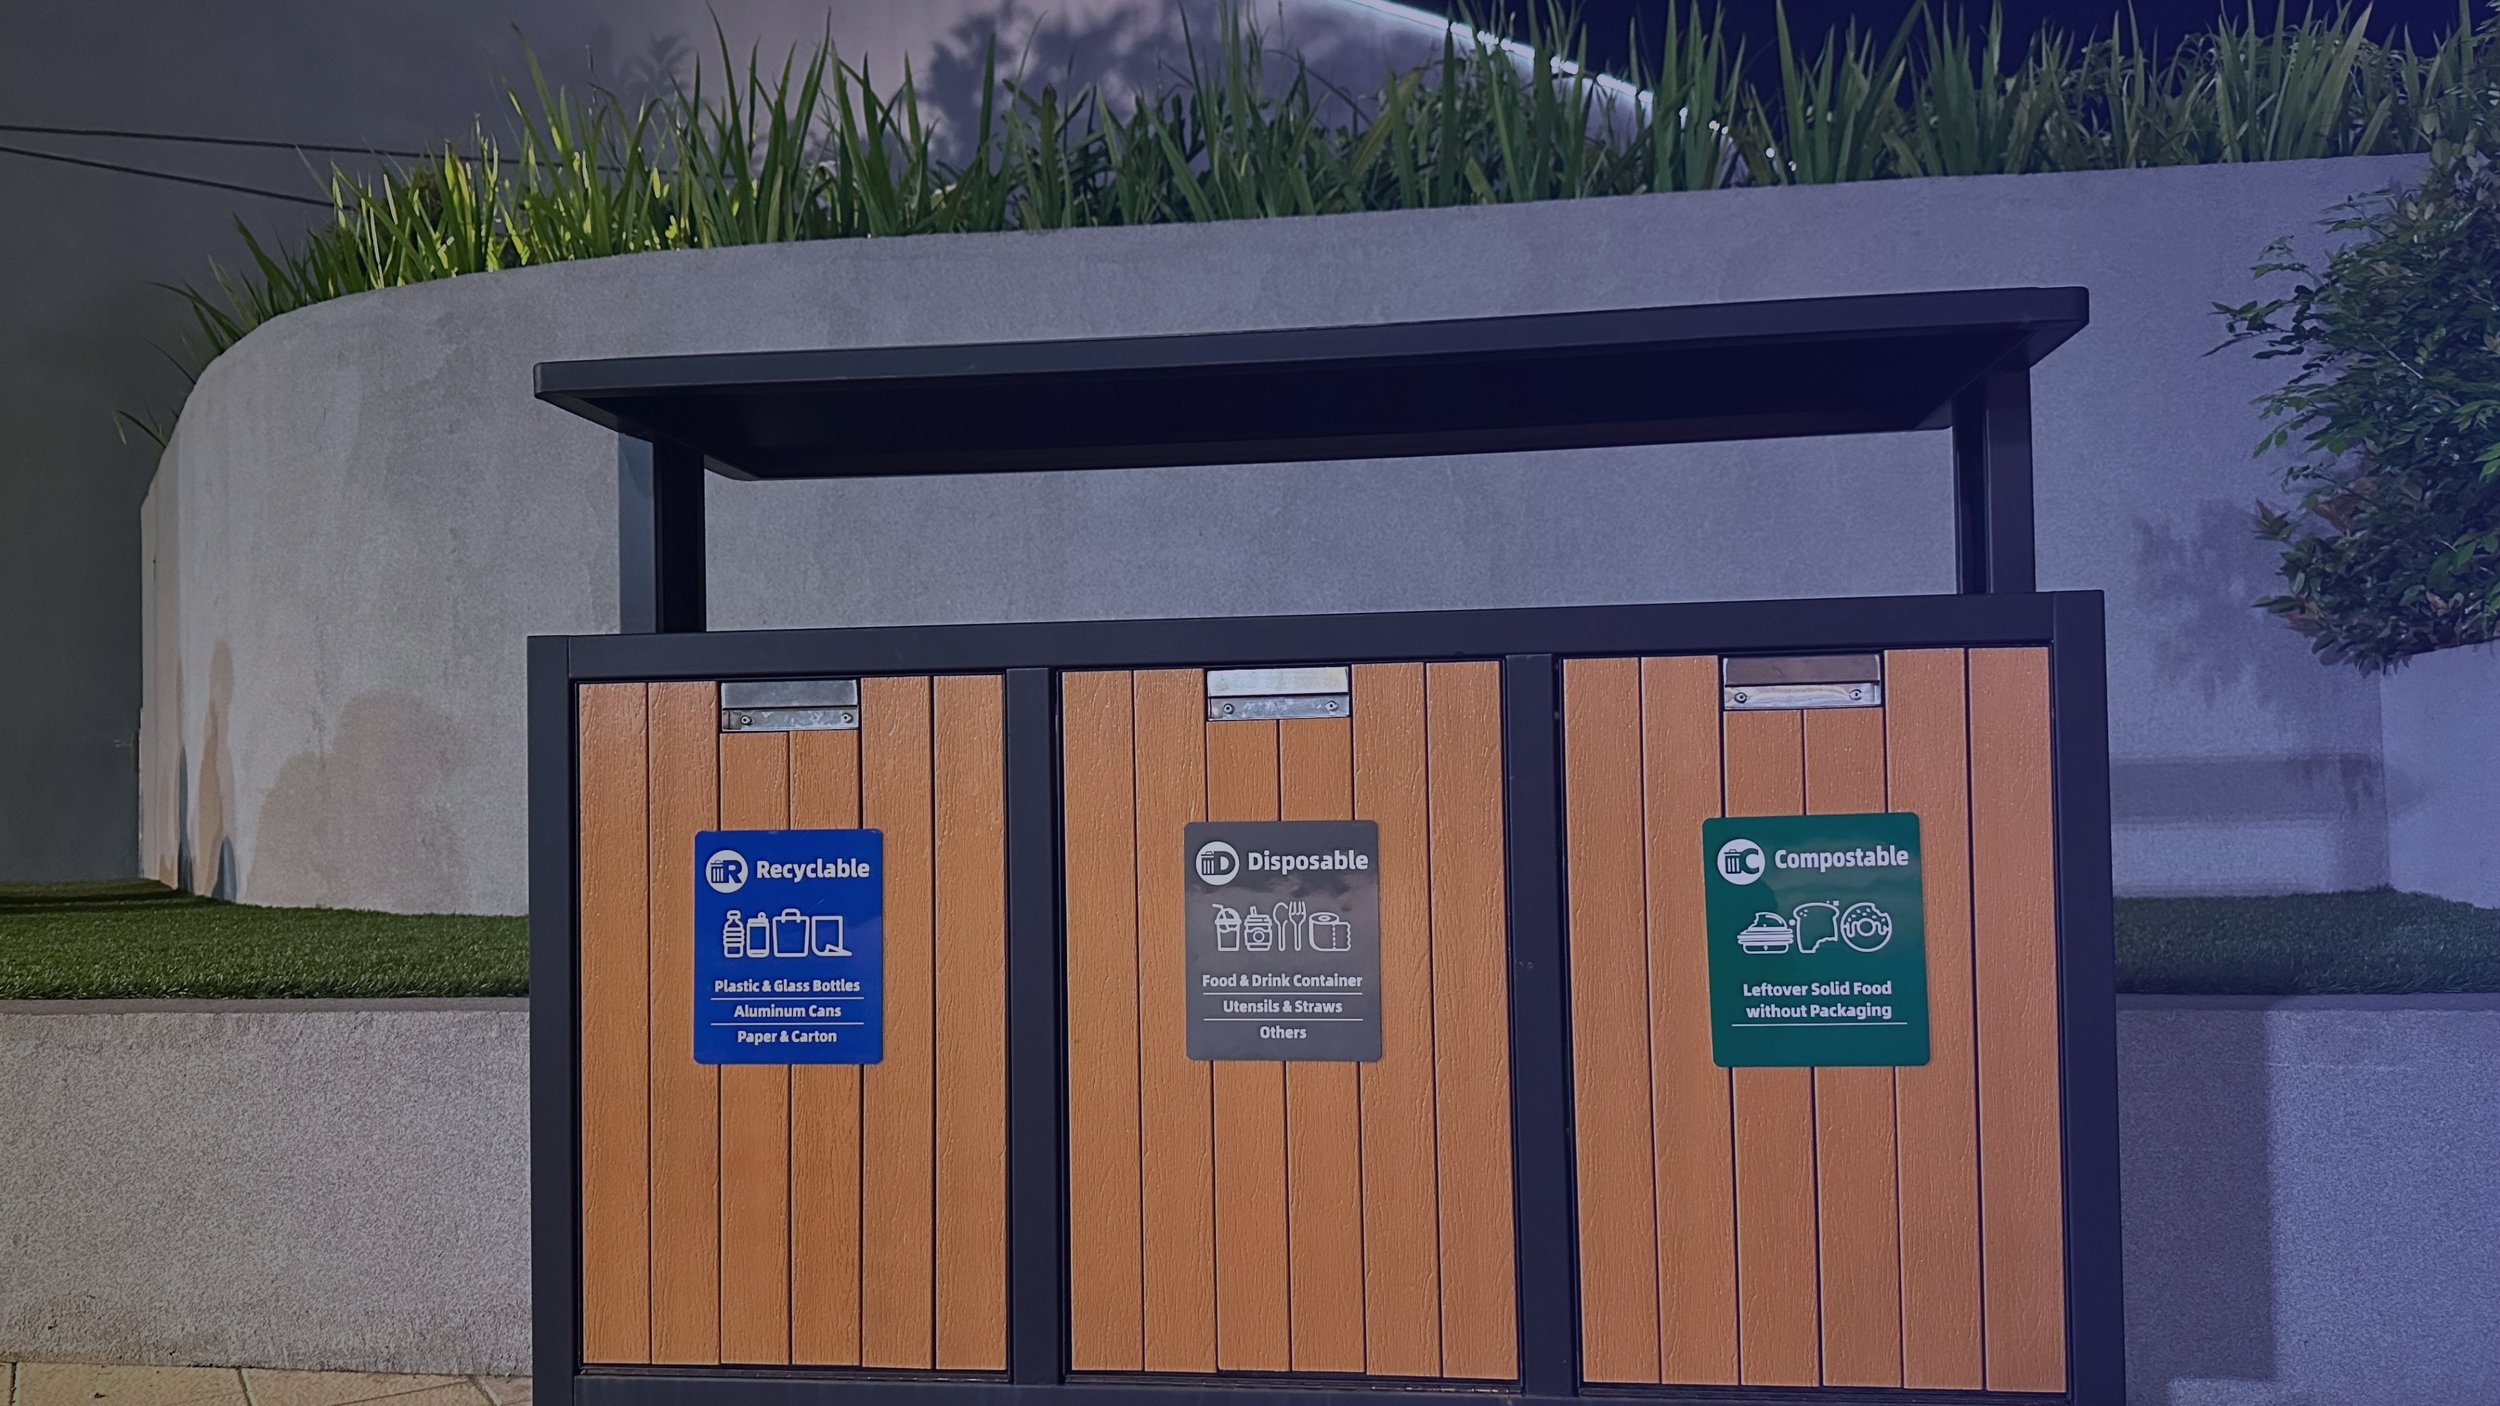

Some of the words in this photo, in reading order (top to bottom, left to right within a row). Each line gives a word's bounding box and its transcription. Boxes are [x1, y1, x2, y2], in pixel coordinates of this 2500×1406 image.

[1249, 850, 1368, 874] Disposable
[1775, 845, 1908, 872] Compostable
[757, 859, 869, 882] Recyclable
[715, 979, 758, 992] Plastic
[762, 980, 771, 992] &
[774, 980, 809, 992] Glass
[813, 979, 860, 992] Bottles
[1203, 974, 1236, 987] Food
[1240, 974, 1249, 987] &
[1252, 973, 1290, 987] Drink
[1293, 973, 1362, 987] Container
[1744, 983, 1807, 996] Leftover
[1811, 982, 1850, 995] Solid
[1854, 981, 1891, 994] Food
[734, 1004, 805, 1018] Aluminum
[809, 1004, 841, 1017] Cans
[1223, 999, 1279, 1013] Utensils
[1282, 1000, 1292, 1012] &
[1295, 1000, 1342, 1012] Straws
[1746, 1004, 1807, 1017] without
[1811, 1003, 1891, 1019] Packaging
[738, 1031, 777, 1045] Paper
[780, 1031, 788, 1042] &
[792, 1031, 837, 1042] Carton
[1260, 1026, 1306, 1038] Others
